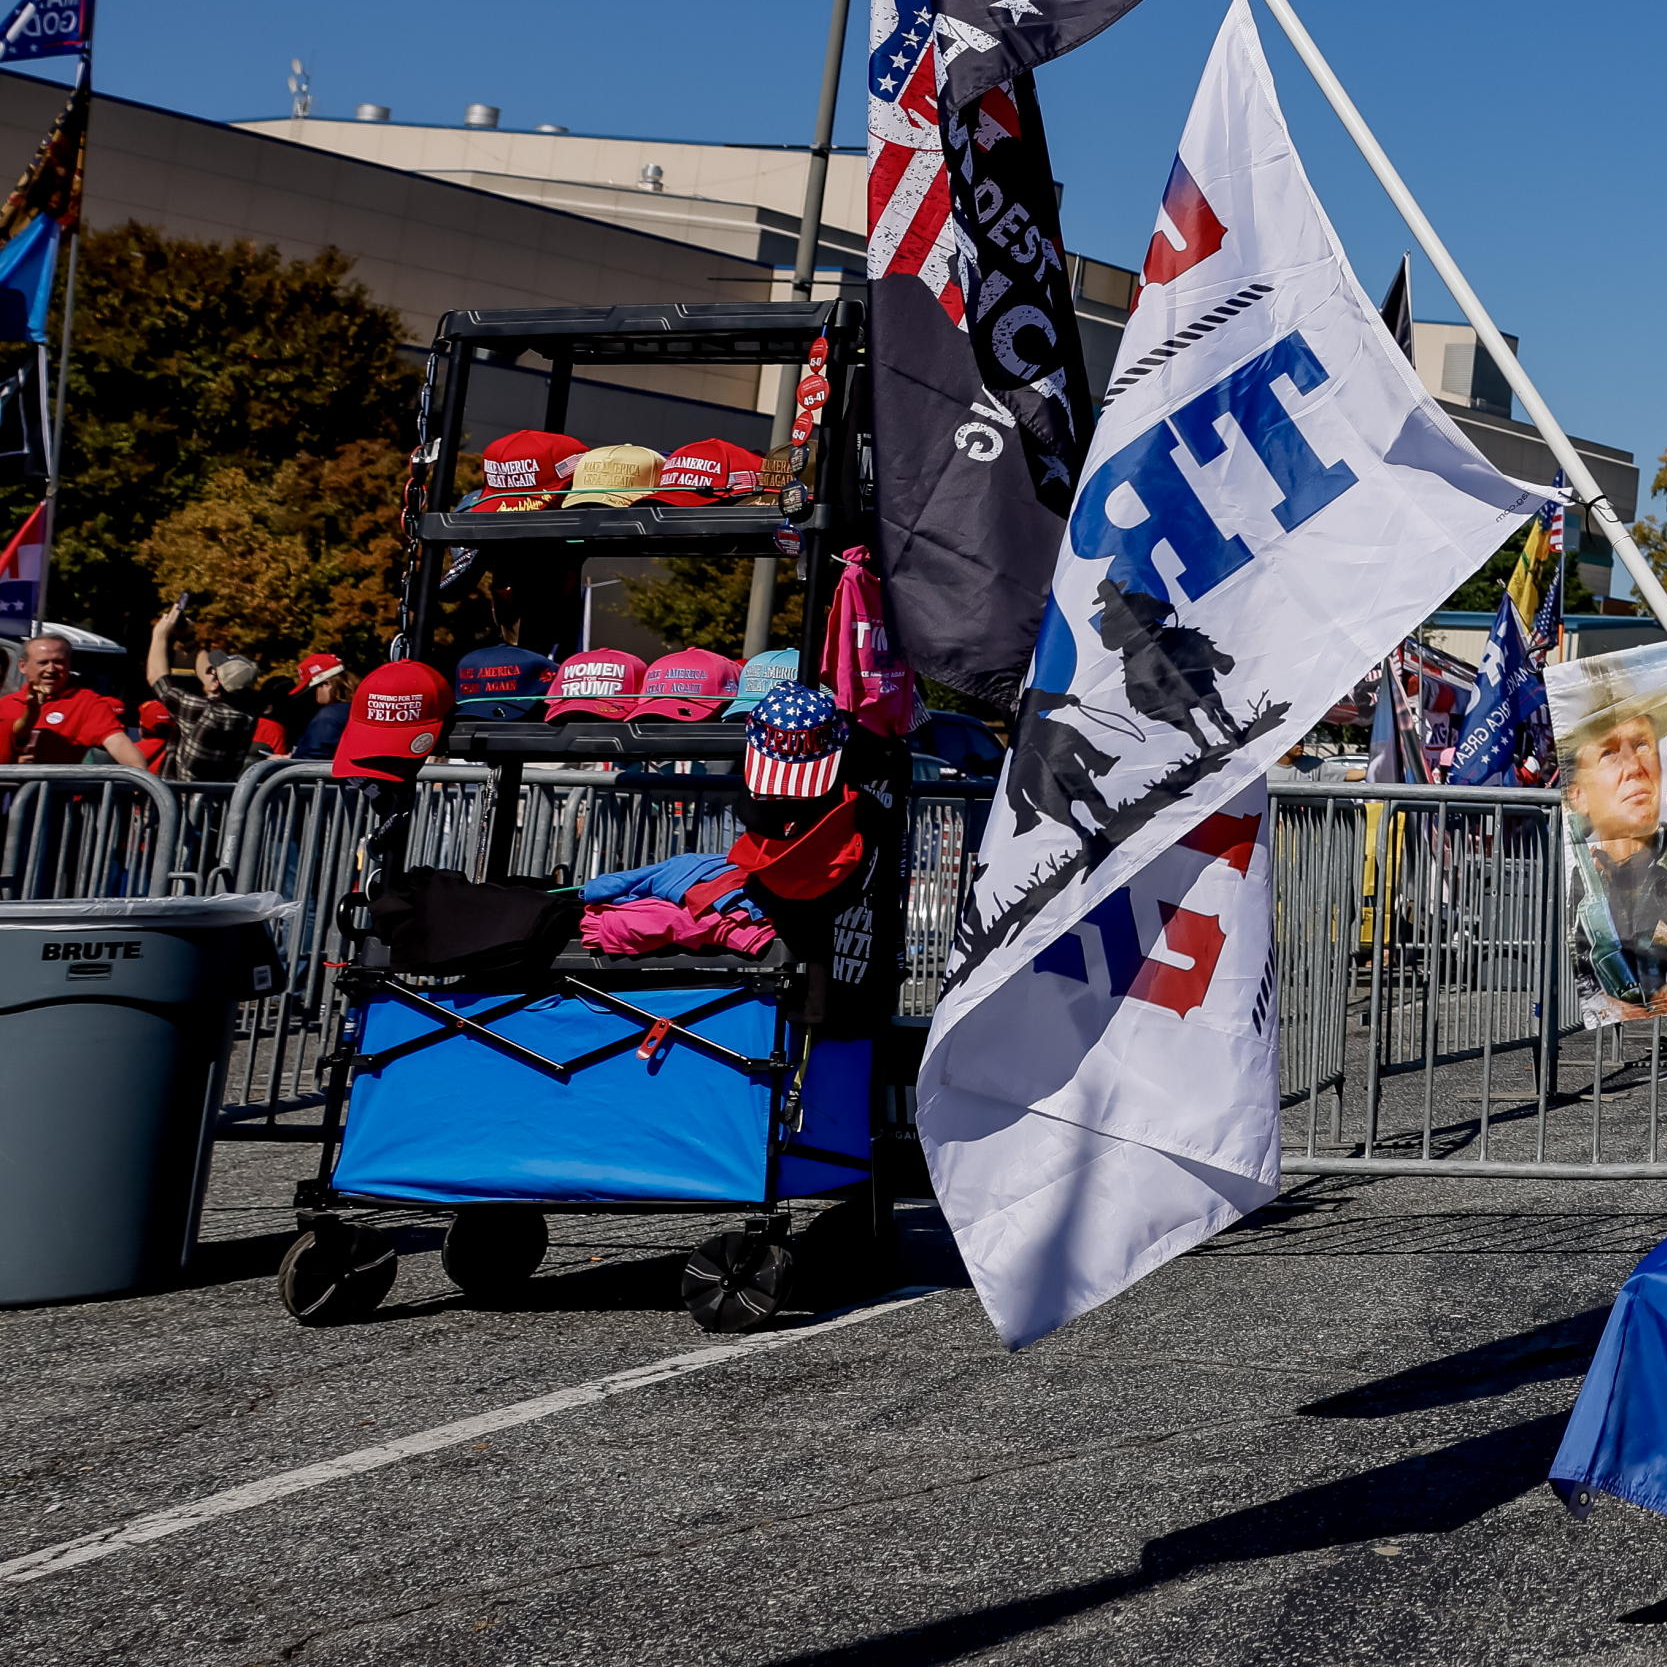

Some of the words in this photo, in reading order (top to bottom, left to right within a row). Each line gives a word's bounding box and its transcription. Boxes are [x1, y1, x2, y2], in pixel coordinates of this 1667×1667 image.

[804, 390, 826, 406] 45-47
[499, 458, 540, 475] AMERICA
[676, 456, 721, 474] AMERICA
[507, 473, 537, 488] AGAIN
[677, 473, 713, 487] AGAIN
[477, 665, 522, 679] AMERICA
[563, 662, 627, 678] WOMEN
[762, 666, 798, 680] AMERIC
[561, 681, 624, 697] TRUMP
[367, 700, 422, 710] CONVICTED
[367, 708, 422, 722] FELON
[42, 940, 142, 961] BRUTE
